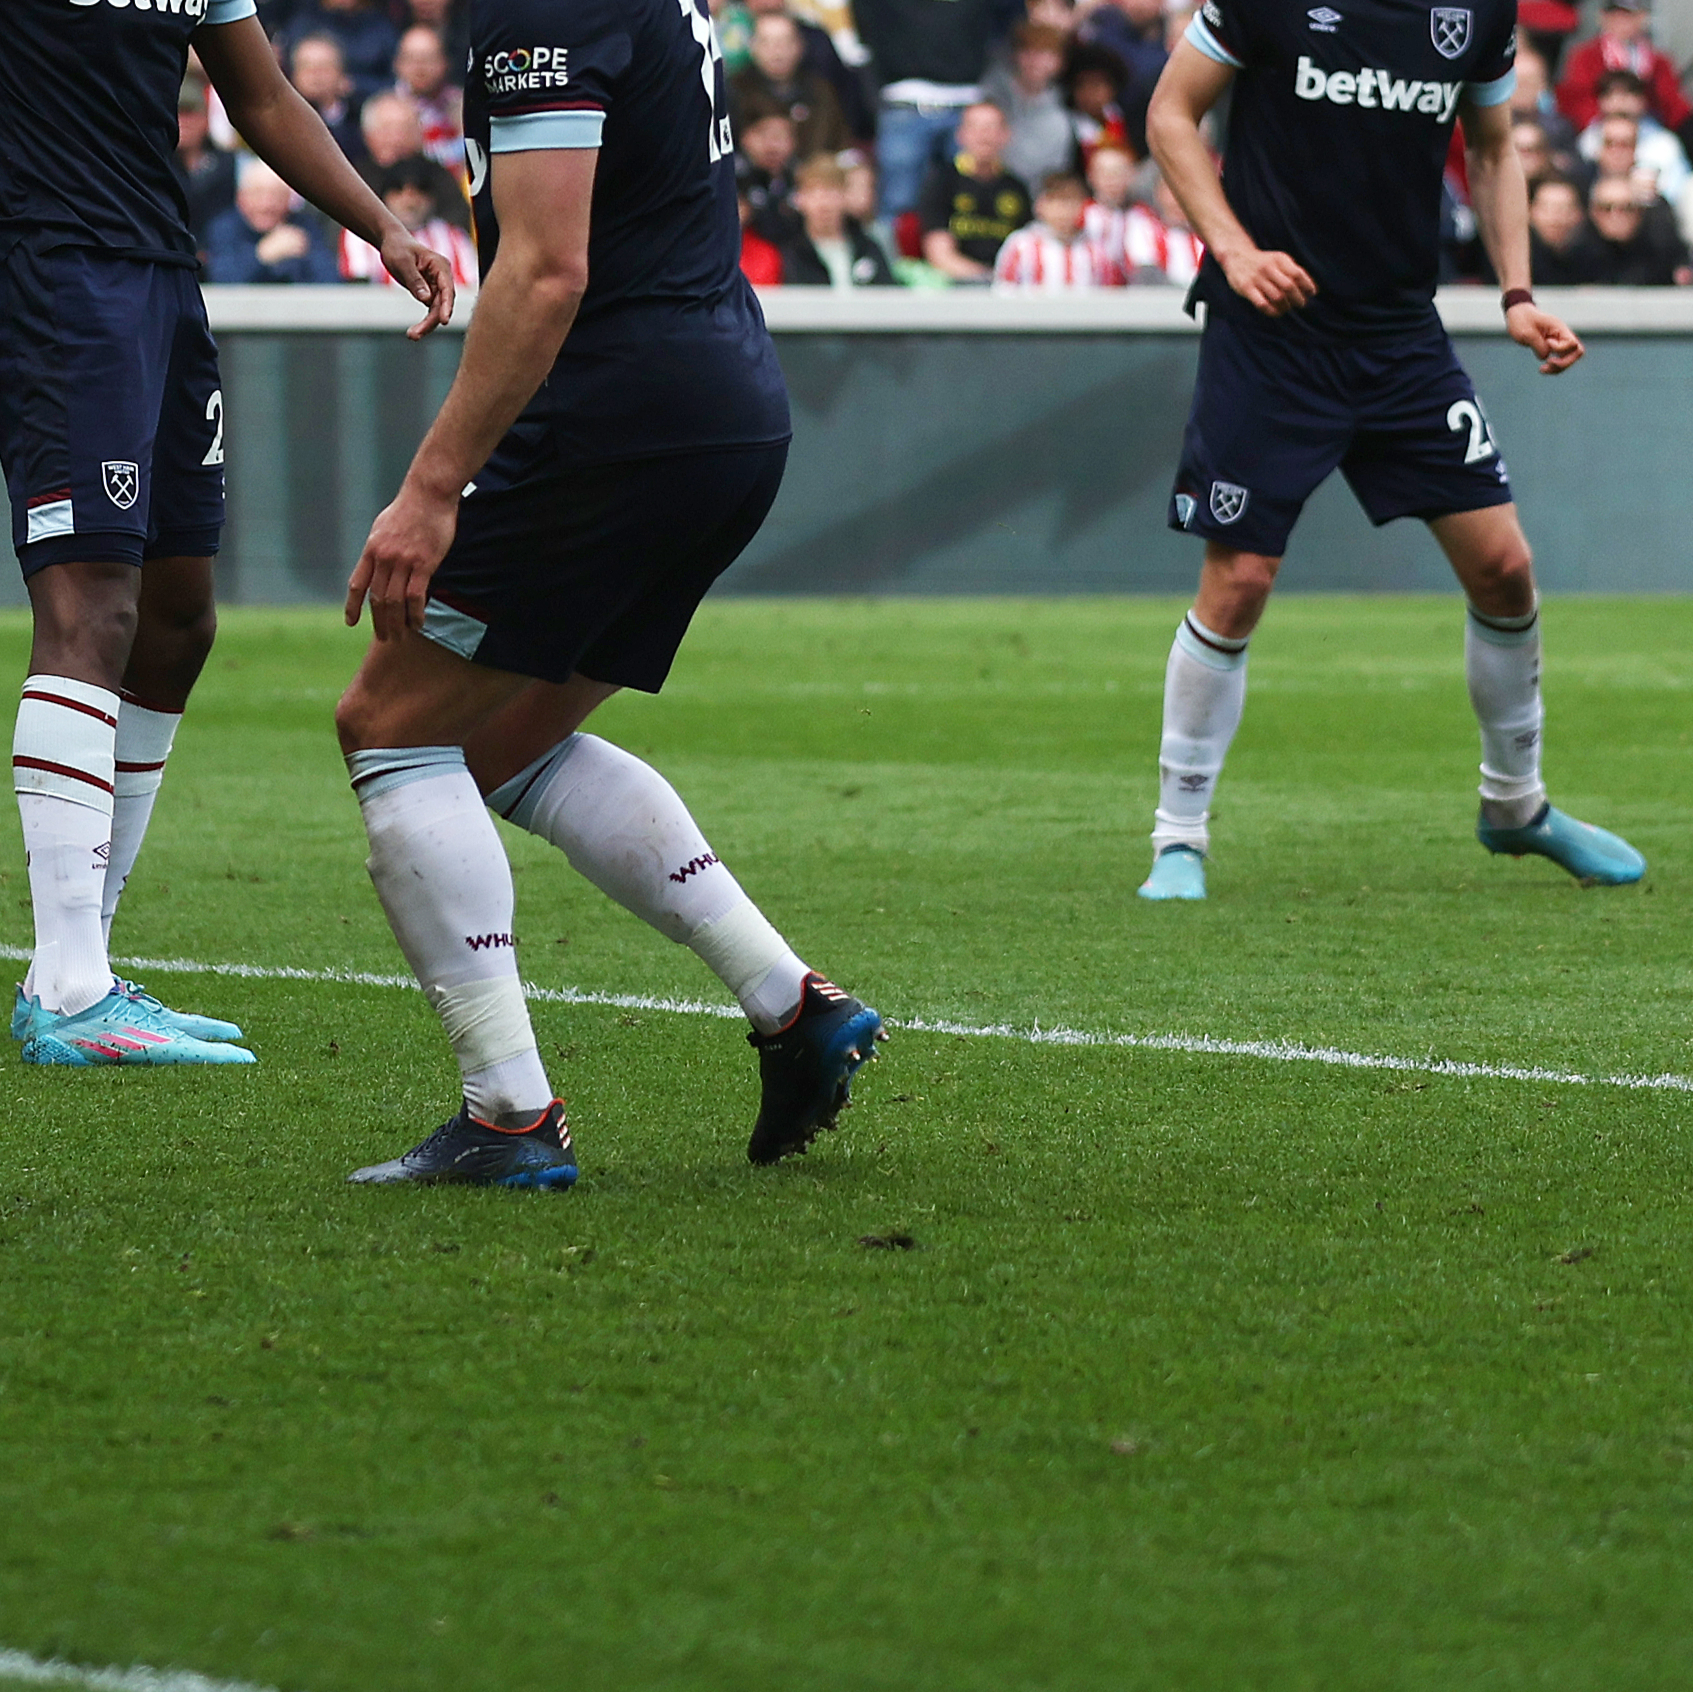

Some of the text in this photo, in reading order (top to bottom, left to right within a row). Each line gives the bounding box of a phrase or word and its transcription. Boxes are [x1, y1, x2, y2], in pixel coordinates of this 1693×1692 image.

[484, 46, 568, 78] SCOPE
[484, 70, 570, 95] MARKETS
[1294, 55, 1464, 124] betway
